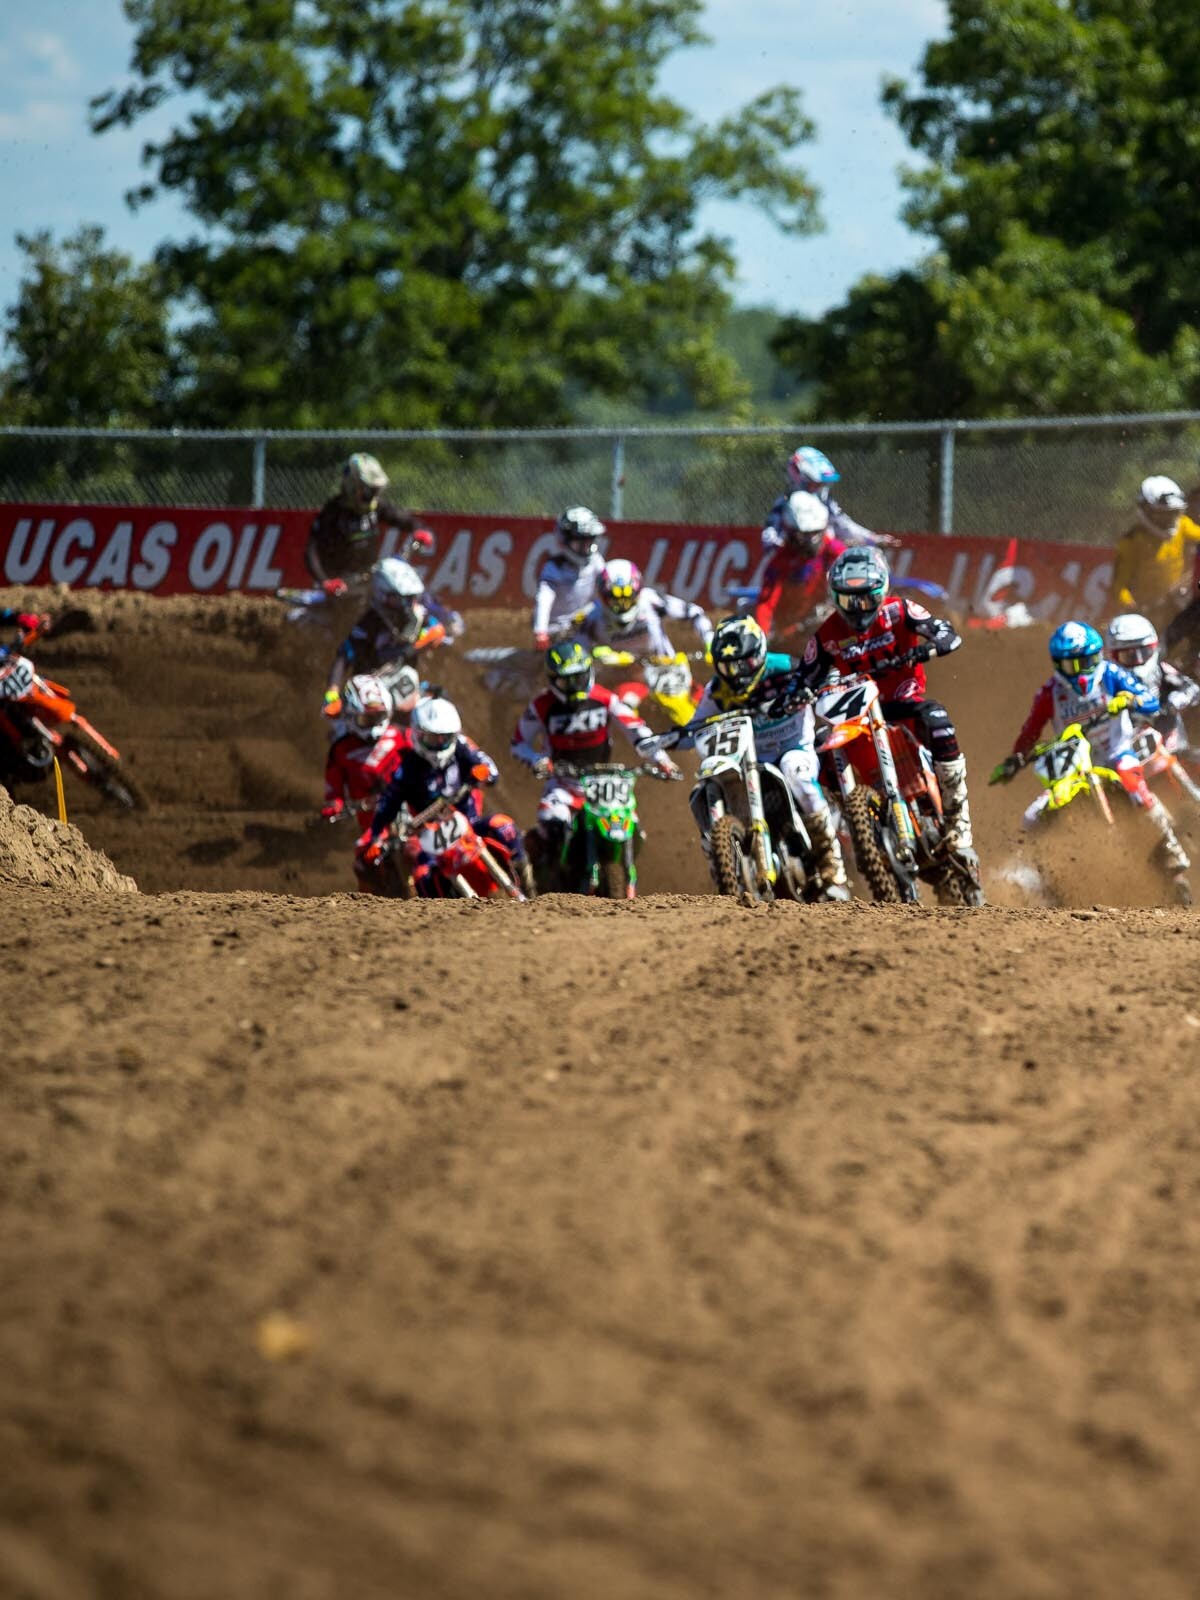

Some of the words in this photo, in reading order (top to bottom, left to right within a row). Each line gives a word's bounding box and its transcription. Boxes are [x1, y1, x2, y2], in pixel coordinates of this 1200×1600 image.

[188, 522, 282, 589] OIL
[644, 538, 775, 607] LUC
[825, 686, 867, 720] 4
[549, 707, 607, 734] FXR
[704, 729, 740, 757] 15
